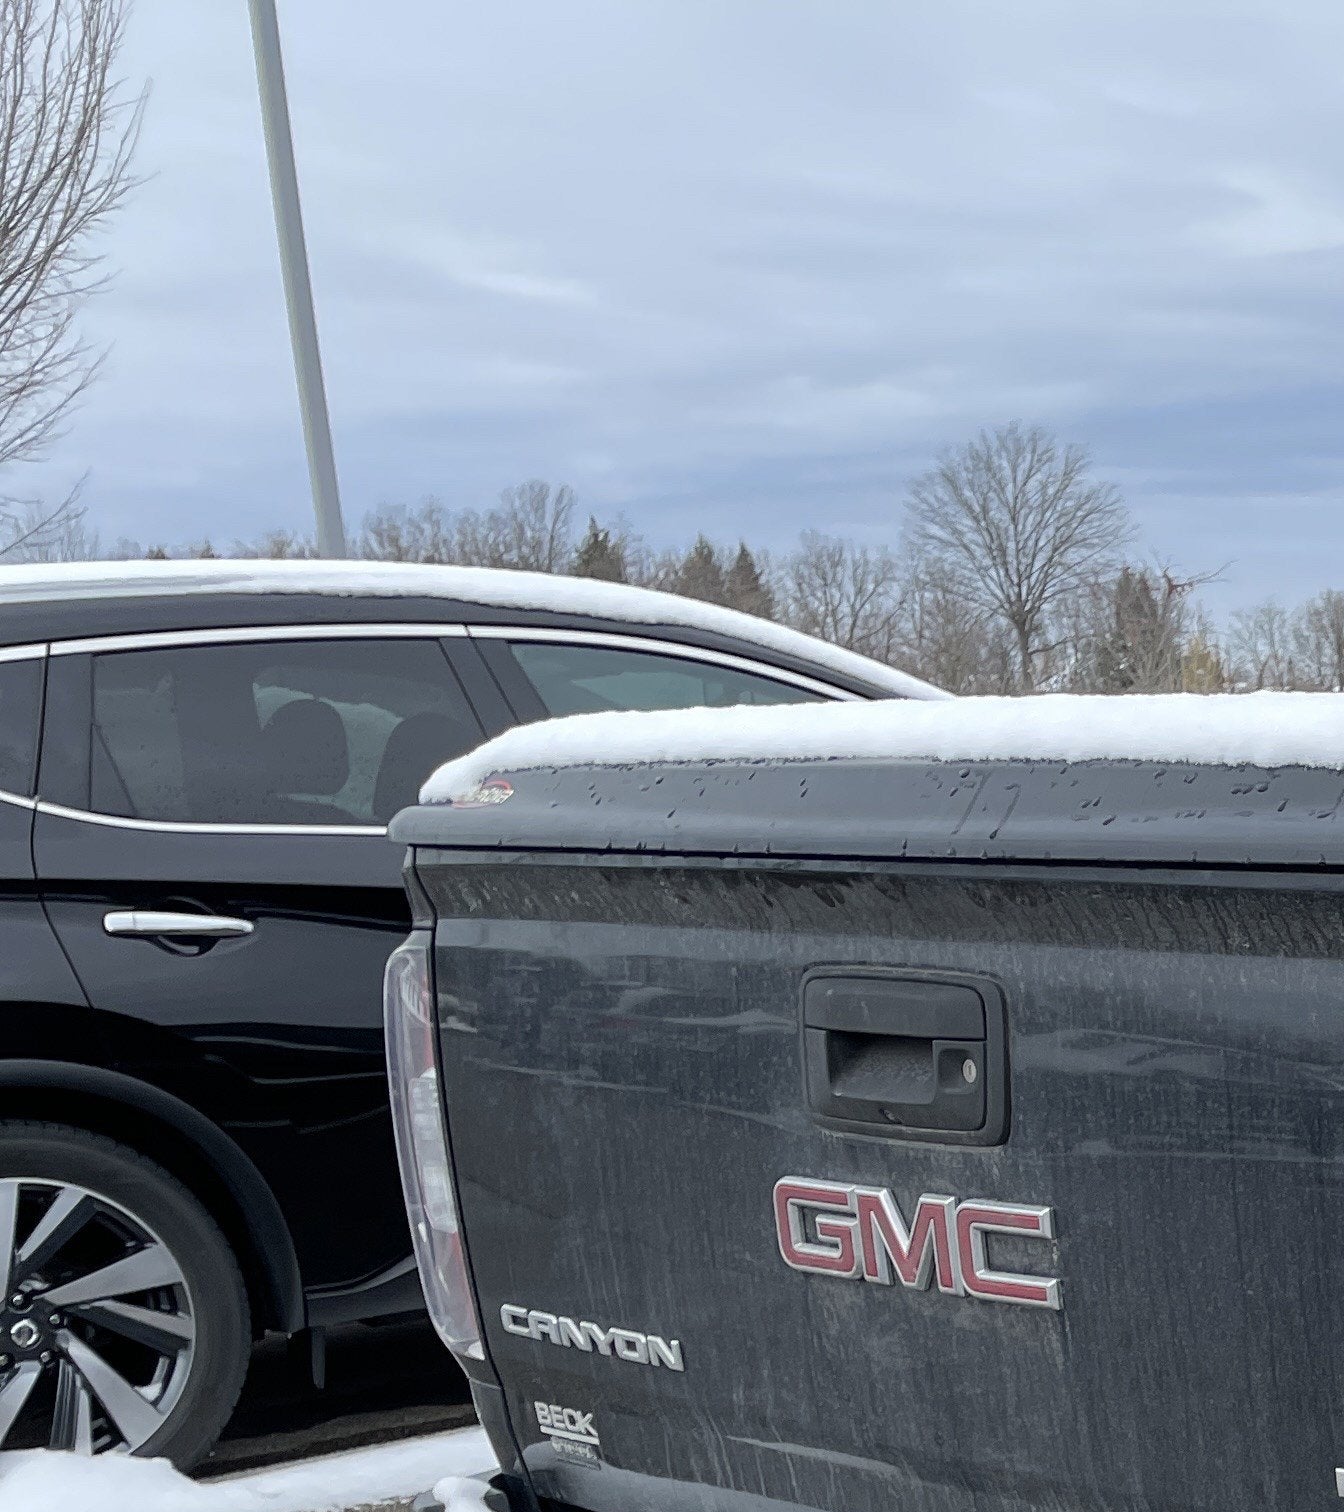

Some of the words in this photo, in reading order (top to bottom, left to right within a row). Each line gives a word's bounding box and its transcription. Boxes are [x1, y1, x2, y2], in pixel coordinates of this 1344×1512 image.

[773, 1174, 1064, 1311] GMC
[500, 1302, 686, 1373] CANYON
[534, 1400, 599, 1438] BECK
